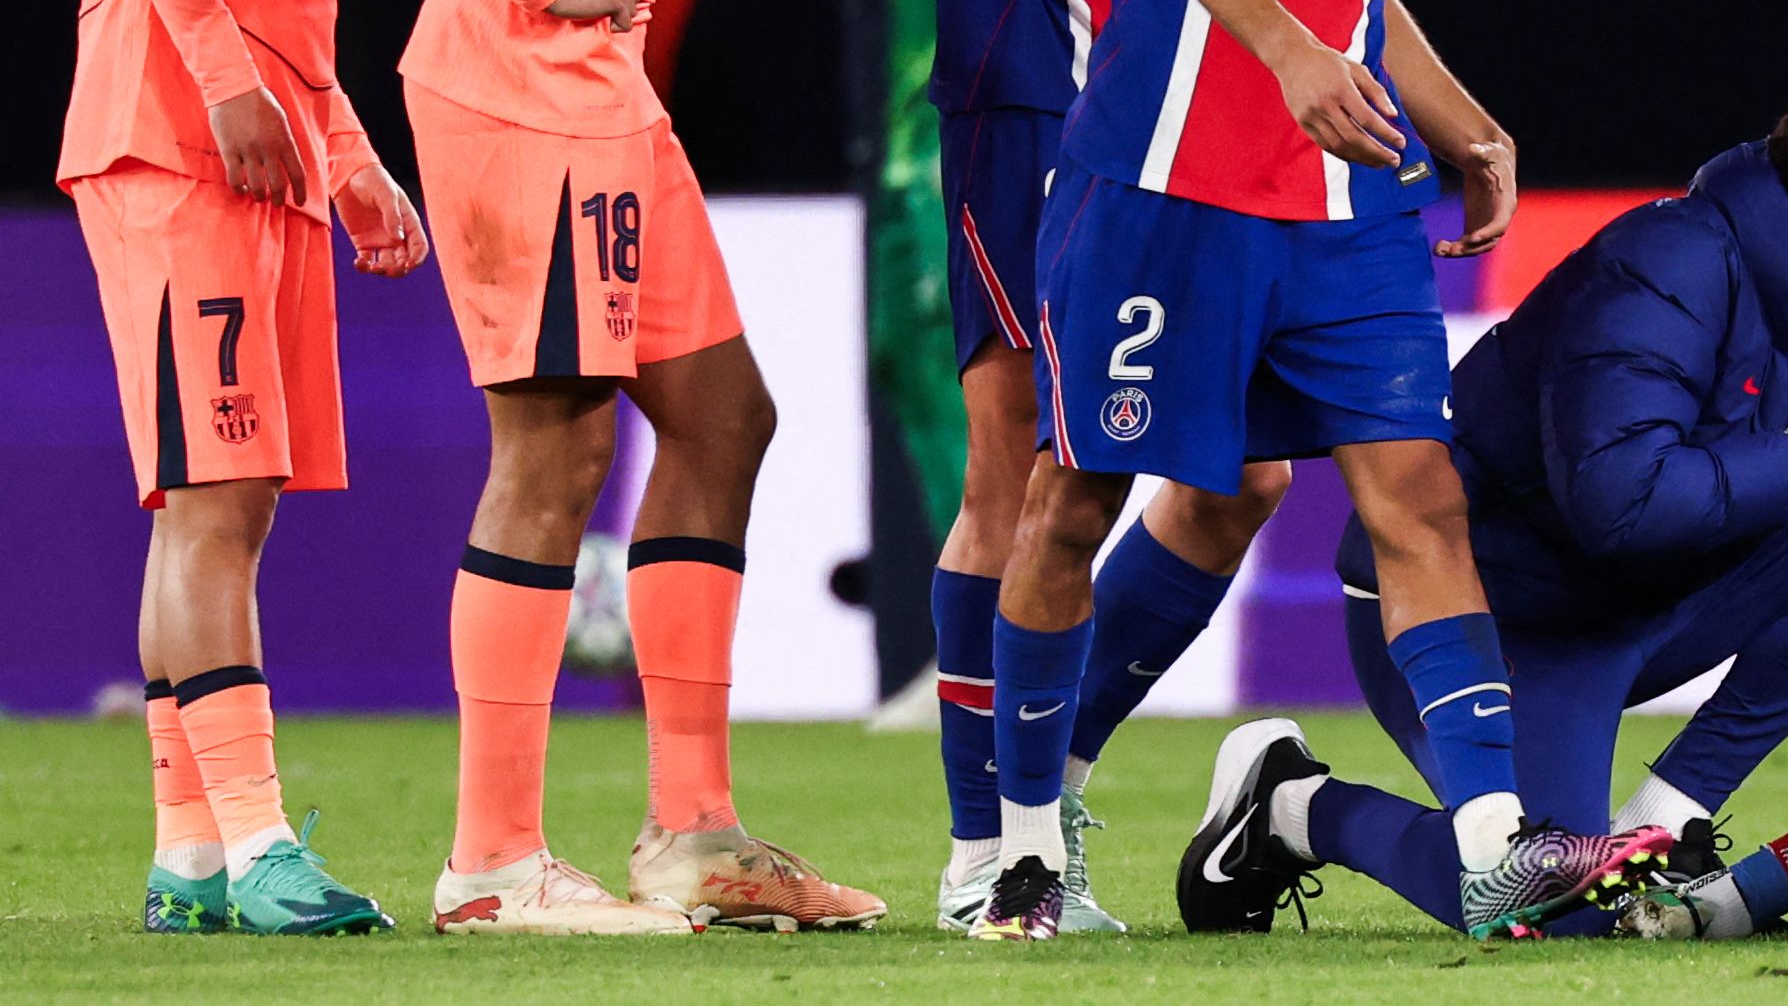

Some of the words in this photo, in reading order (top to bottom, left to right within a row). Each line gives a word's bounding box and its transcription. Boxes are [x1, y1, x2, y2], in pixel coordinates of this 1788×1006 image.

[581, 191, 641, 284] 18
[197, 297, 245, 387] 7
[1108, 295, 1165, 381] 2
[1112, 389, 1144, 403] PARIS
